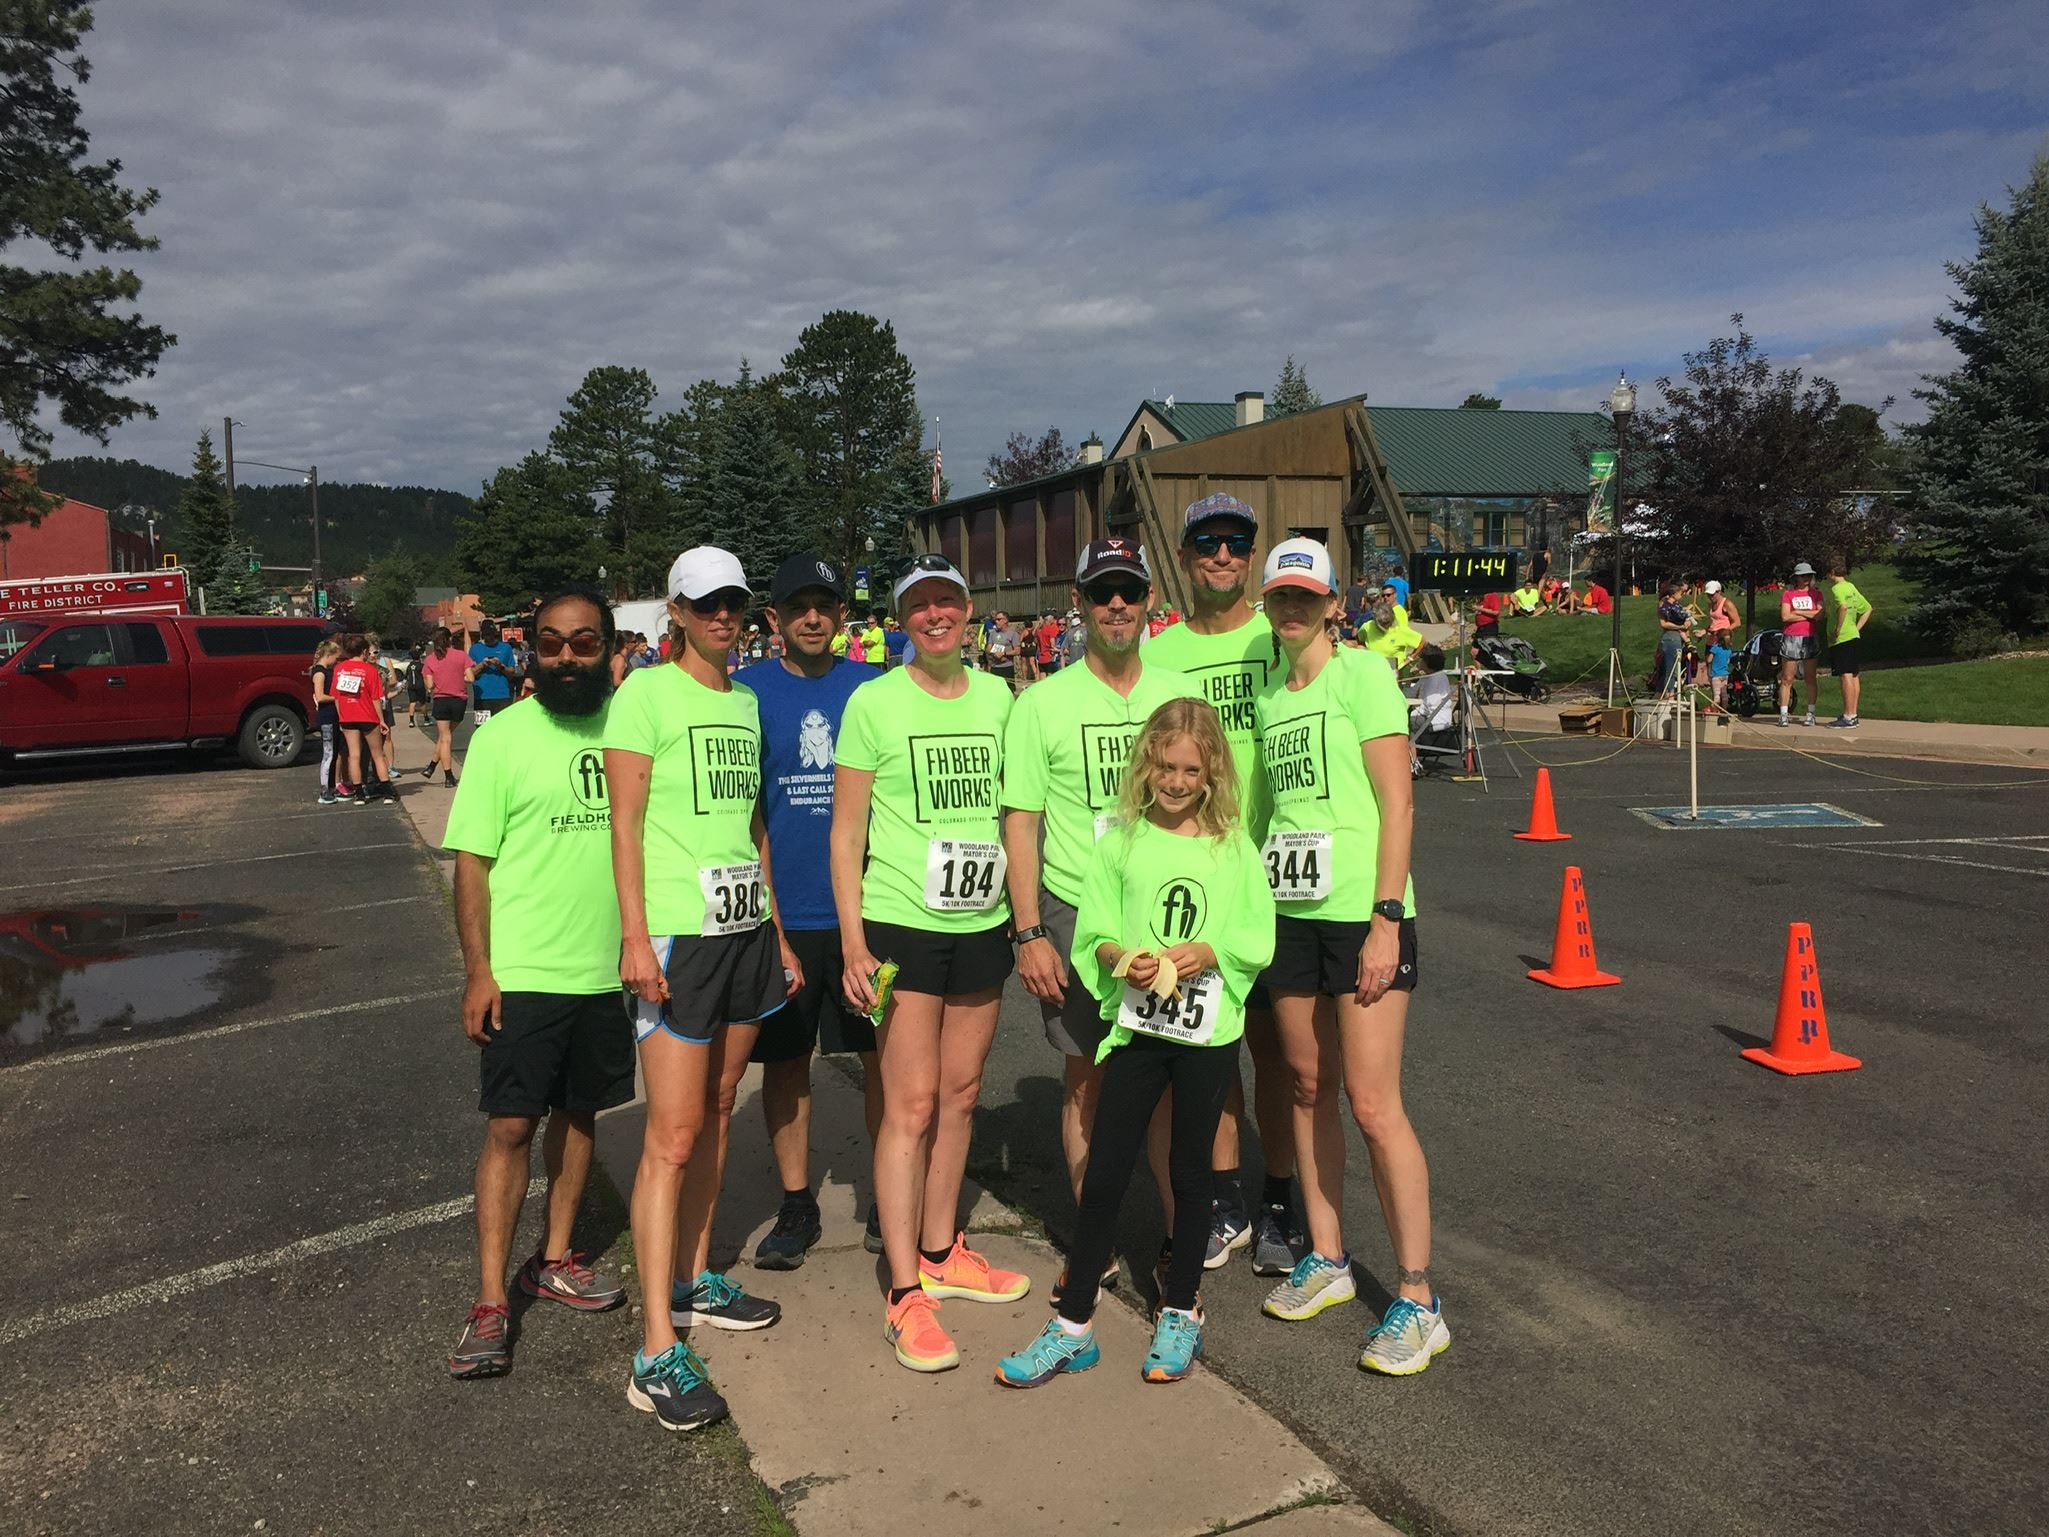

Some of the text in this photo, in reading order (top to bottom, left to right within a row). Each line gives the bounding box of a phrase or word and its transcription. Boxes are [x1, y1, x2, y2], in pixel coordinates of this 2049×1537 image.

[9, 594, 103, 610] FIRE DISTRICT
[18, 582, 85, 596] TELLER
[92, 582, 122, 592] CO.
[340, 680, 358, 690] 352
[1212, 672, 1254, 702] BEER
[705, 737, 757, 767] FH BEER
[1097, 736, 1121, 763] FH
[1278, 726, 1310, 758] BEER
[926, 746, 991, 776] FH BEER
[708, 769, 759, 800] WORKS
[793, 786, 809, 794] LAST
[810, 785, 827, 793] CALL
[928, 777, 992, 810] WORKS
[1282, 832, 1310, 840] WOODLAND
[1310, 832, 1326, 840] PARK
[939, 860, 995, 898] 184
[1267, 850, 1320, 889] 344
[715, 881, 760, 924] 380
[1288, 890, 1315, 898] FOOTRACE
[1197, 977, 1210, 986] CUP
[1200, 970, 1217, 980] PARK
[1135, 985, 1208, 1030] 345
[1161, 1025, 1194, 1039] FOOTRACE
